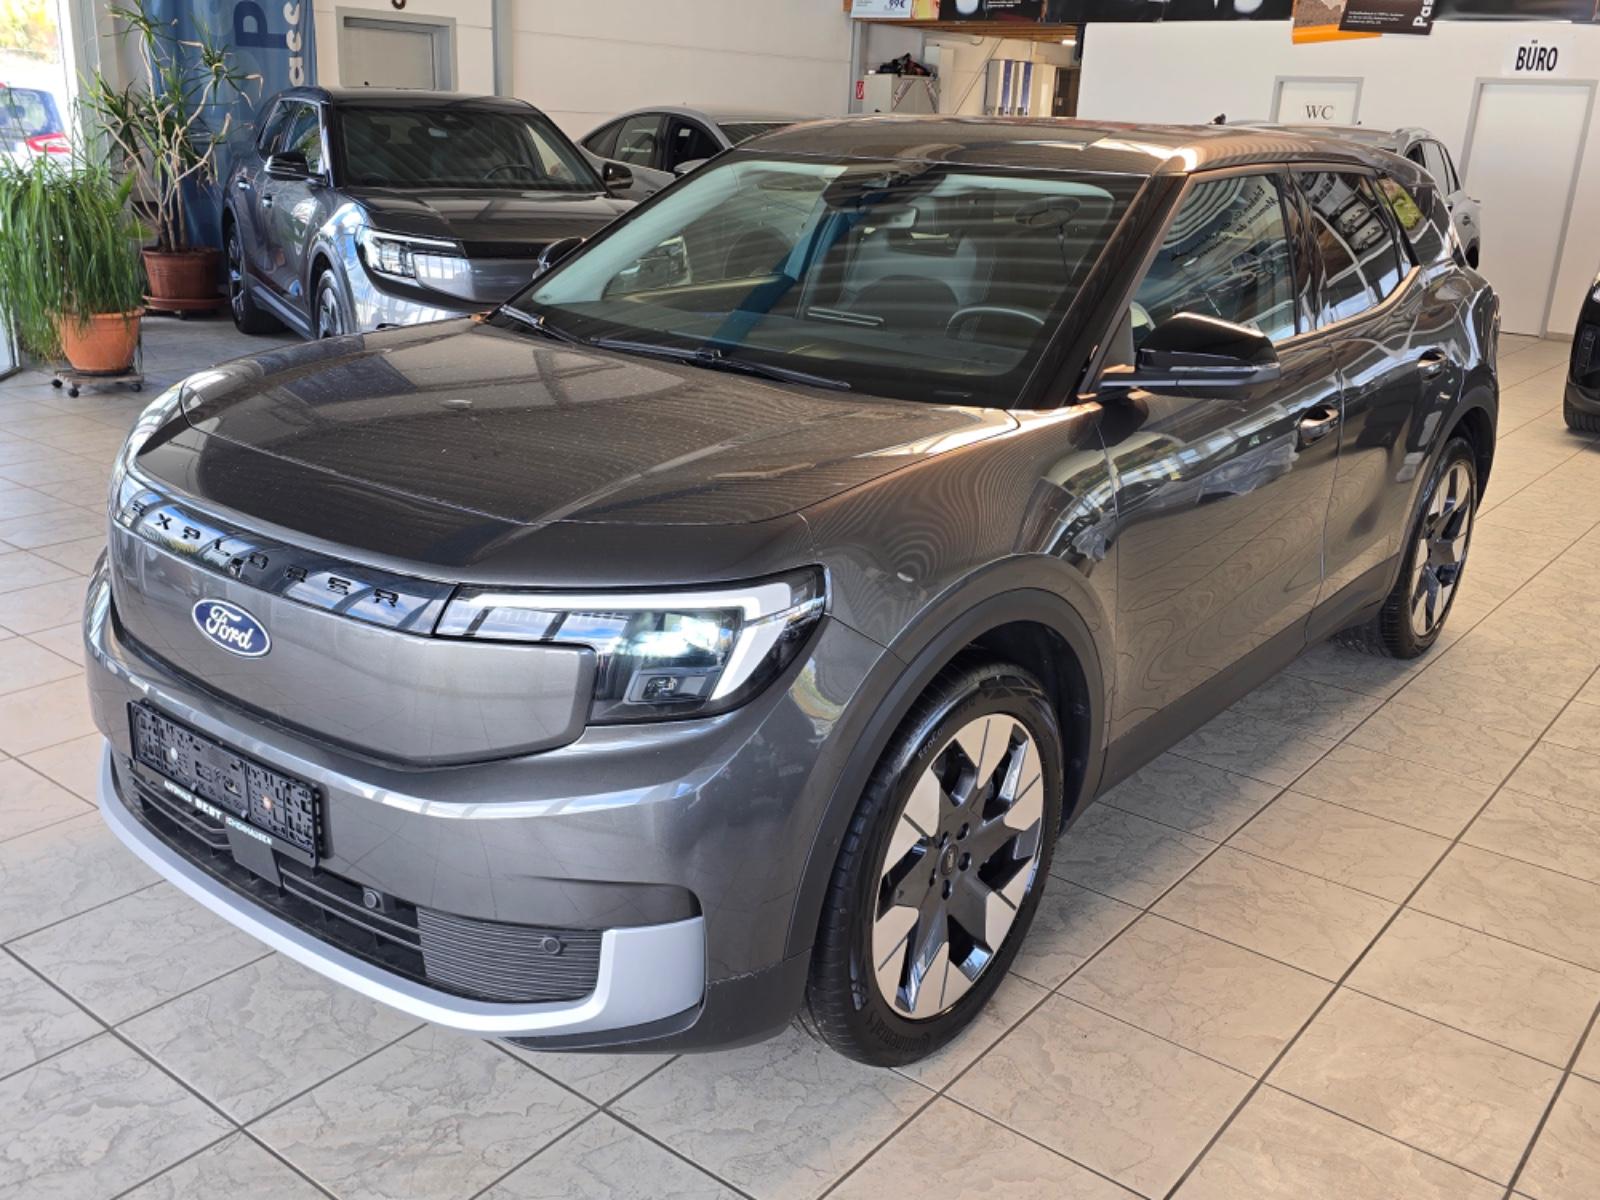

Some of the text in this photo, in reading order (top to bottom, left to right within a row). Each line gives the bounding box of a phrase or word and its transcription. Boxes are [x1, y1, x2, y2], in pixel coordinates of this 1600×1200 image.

[1515, 39, 1558, 71] BÜRO
[1305, 104, 1334, 120] WC
[205, 605, 254, 650] Ford
